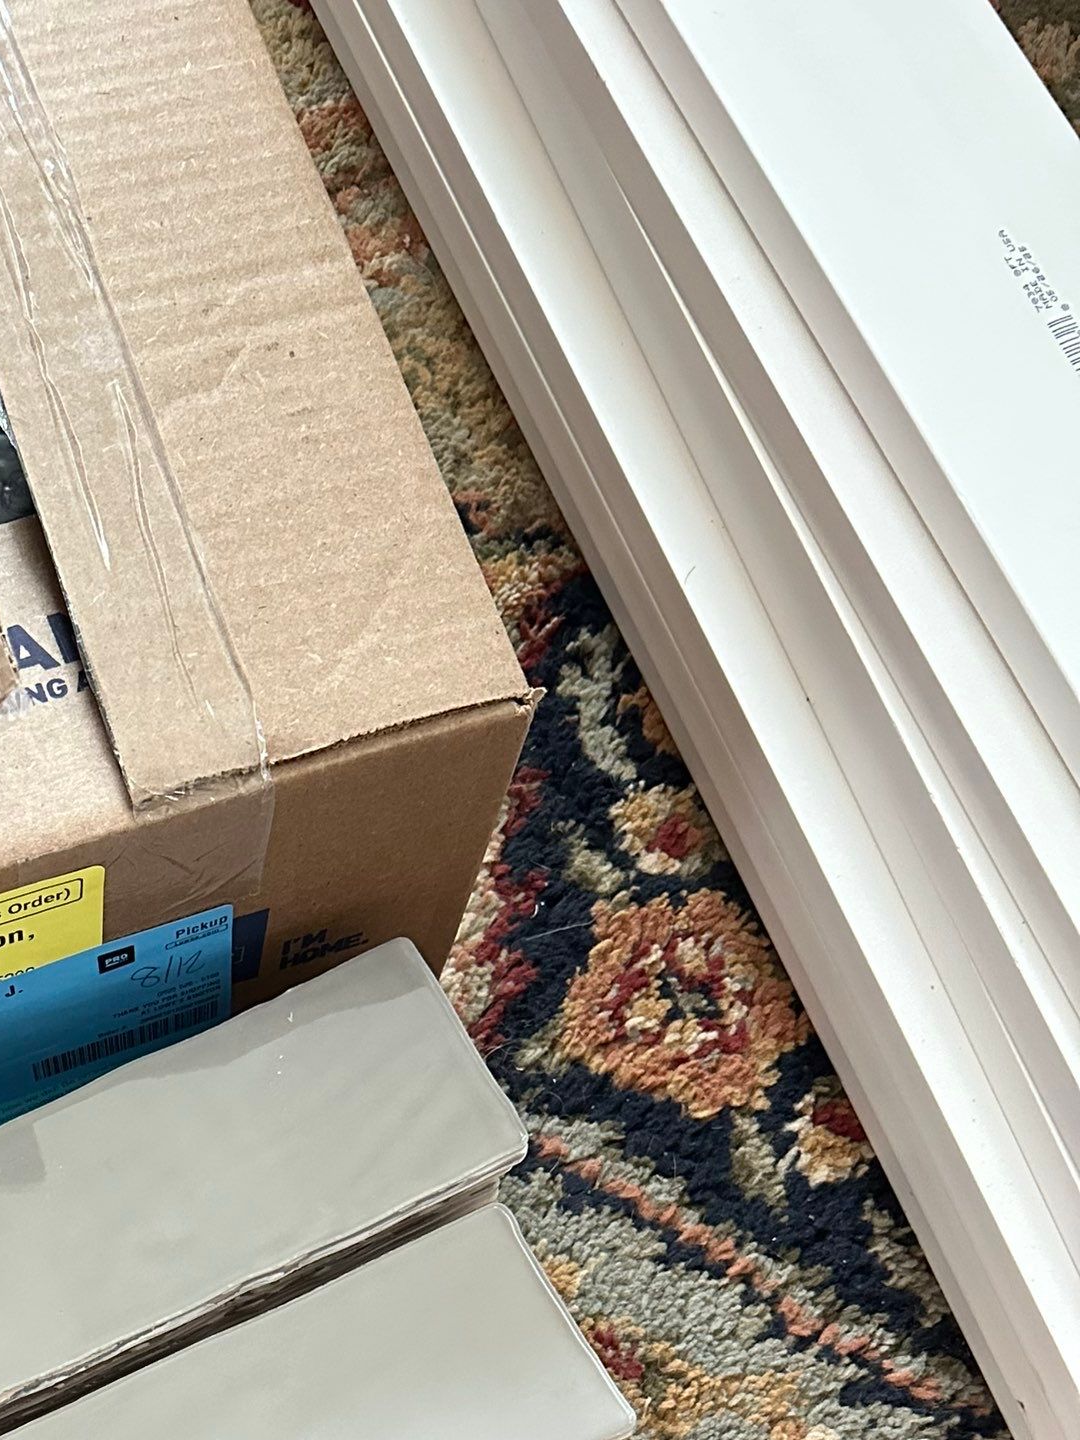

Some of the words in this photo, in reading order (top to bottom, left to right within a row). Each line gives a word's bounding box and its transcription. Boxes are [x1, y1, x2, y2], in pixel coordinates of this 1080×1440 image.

[998, 229, 1016, 252] USA
[1016, 257, 1029, 272] IN
[1029, 280, 1052, 309] MADE
[8, 888, 71, 914] Order)
[175, 915, 228, 939] Pickup
[105, 953, 128, 966] PRO
[5, 984, 23, 998] J.
